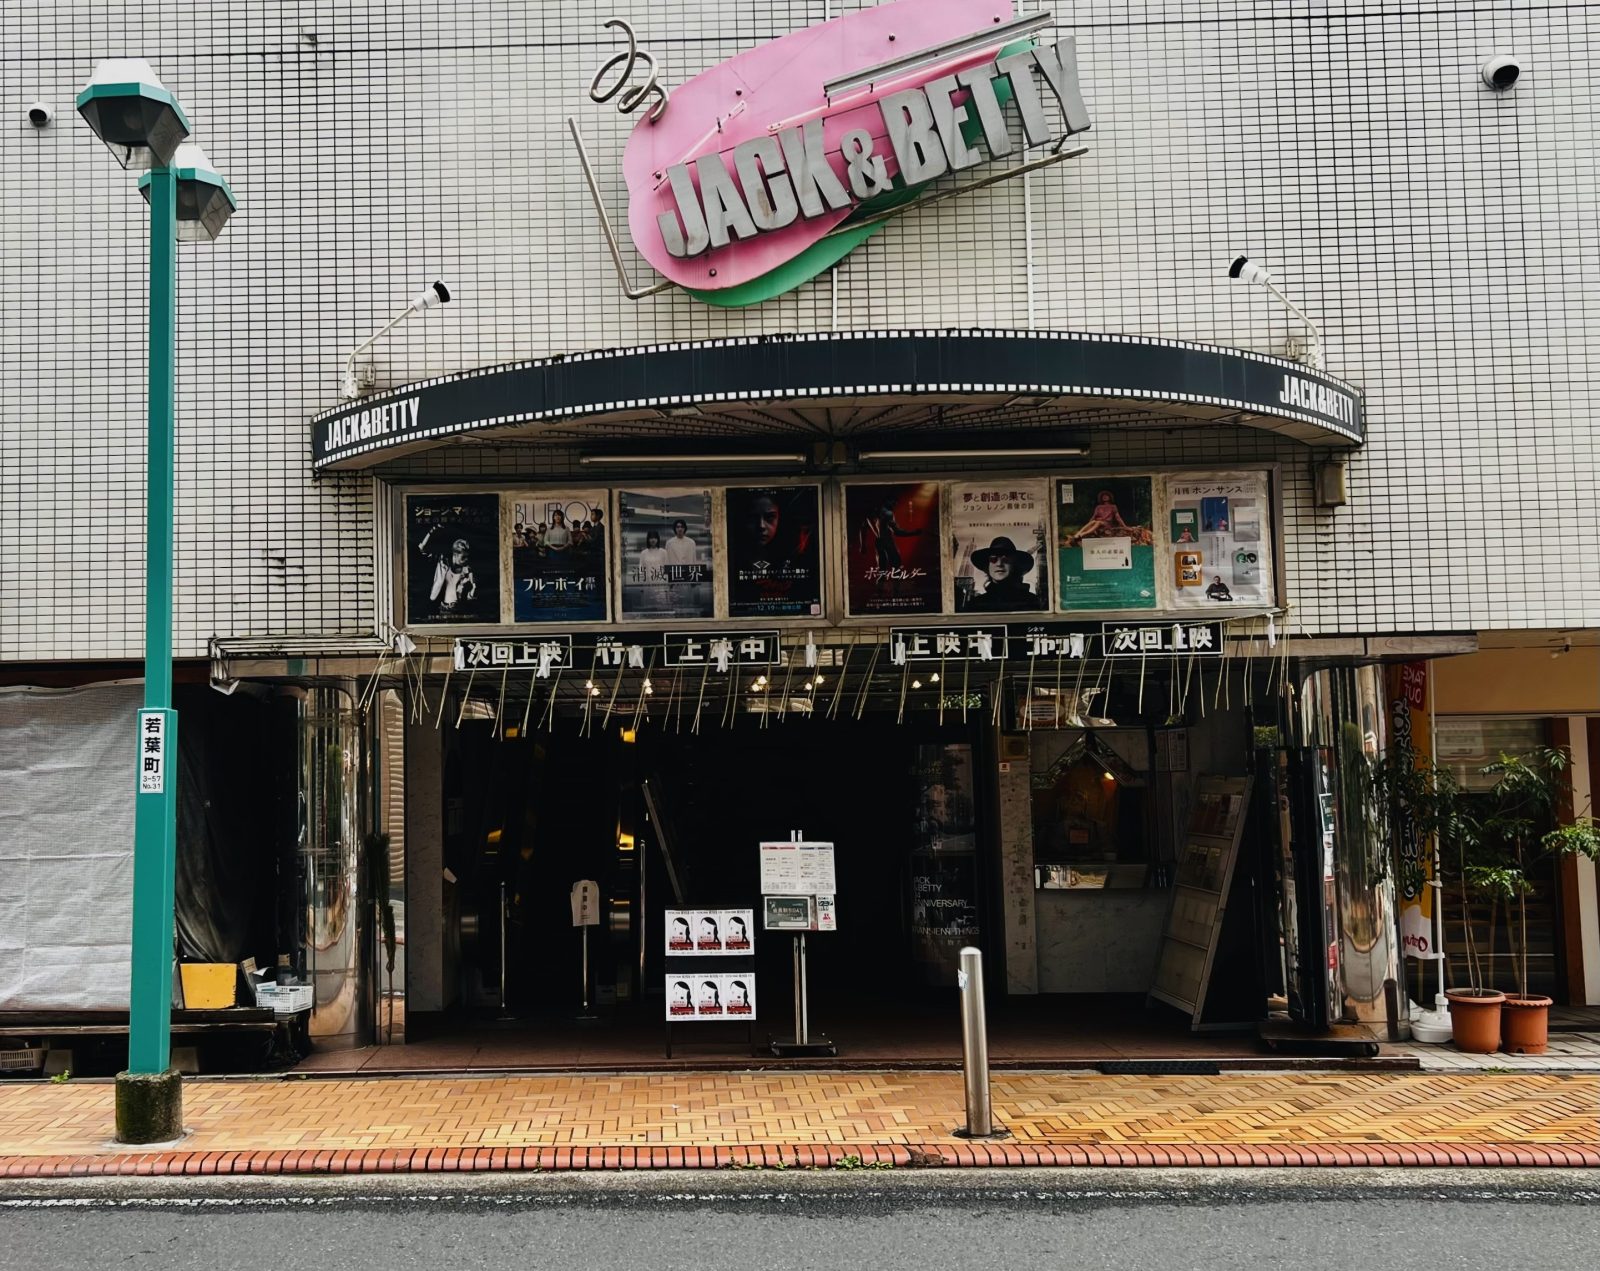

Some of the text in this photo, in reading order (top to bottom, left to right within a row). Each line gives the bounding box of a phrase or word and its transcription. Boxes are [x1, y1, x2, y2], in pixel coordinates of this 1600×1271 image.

[656, 35, 1093, 259] JACK & BETTY
[1279, 374, 1354, 426] JACK&BETTY
[324, 396, 420, 452] JACK&BETTY
[963, 491, 1034, 503] 夢と創造の果てに
[632, 565, 703, 582] 消滅世界
[864, 566, 928, 585] ボディビルダー
[1026, 633, 1085, 657] ジャッ
[1115, 626, 1213, 651] 次回上映
[467, 641, 562, 665] 次回上映
[144, 717, 161, 773] 若葉町
[914, 884, 942, 893] BETTY
